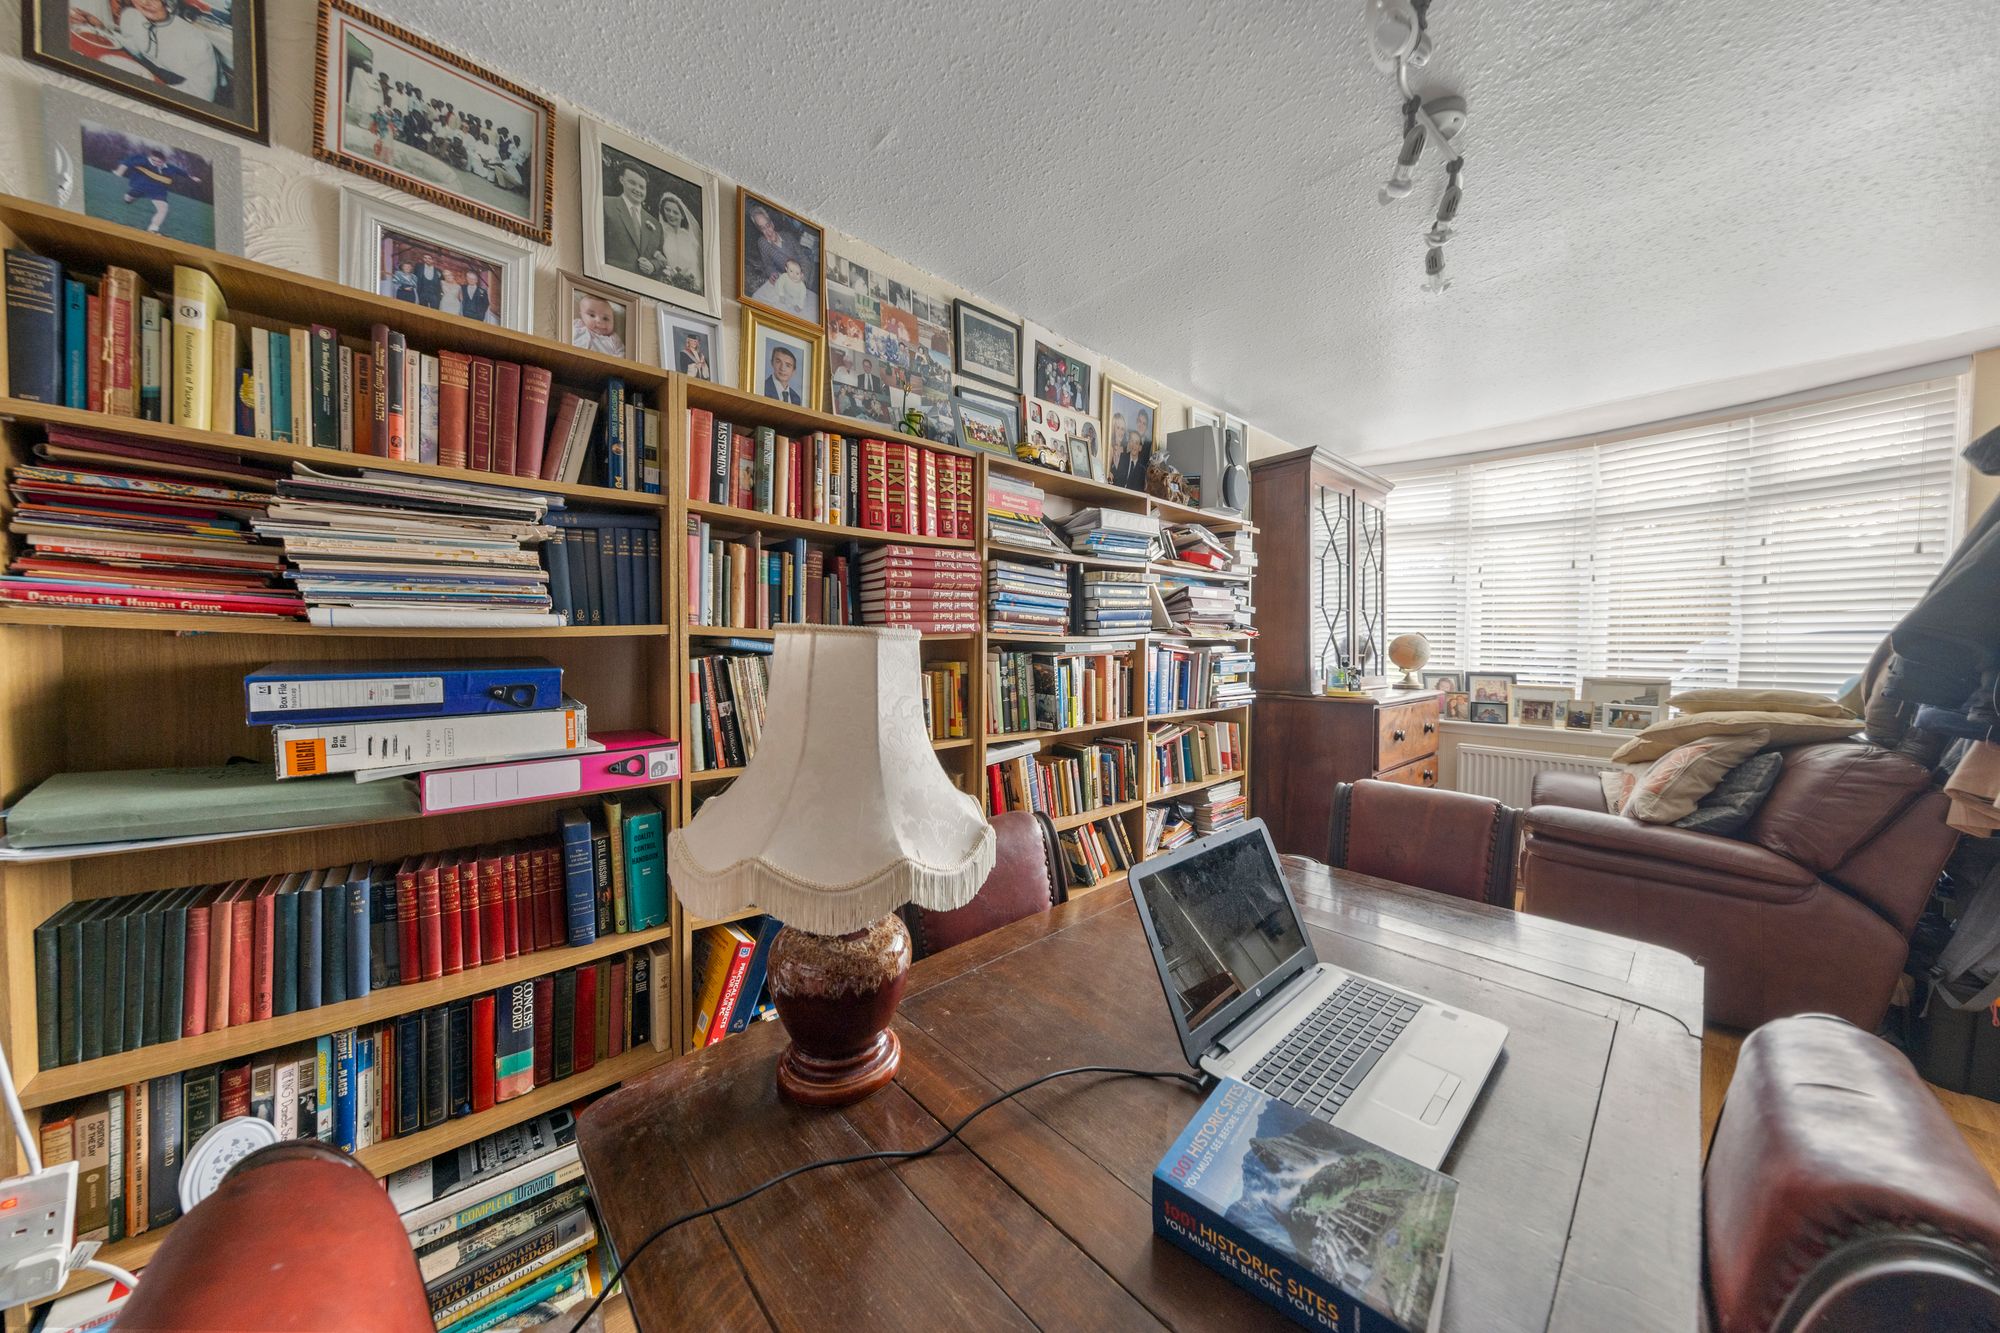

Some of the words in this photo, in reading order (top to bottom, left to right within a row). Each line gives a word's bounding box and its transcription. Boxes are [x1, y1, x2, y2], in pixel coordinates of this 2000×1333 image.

[183, 331, 195, 374] Fundamentals
[374, 367, 385, 391] Family
[183, 385, 195, 418] Packaging
[375, 391, 385, 422] HEALTH
[716, 421, 728, 476] MASTERMIND
[850, 456, 858, 493] CHAMPIONS
[867, 454, 885, 484] FIX
[887, 458, 905, 487] FIX
[908, 462, 918, 492] FIX
[926, 464, 936, 493] FIX
[938, 468, 955, 496] FIX
[956, 470, 972, 498] FIX
[867, 486, 885, 504] IT
[887, 490, 905, 506] IT
[927, 494, 937, 512] IT
[939, 497, 955, 513] IT
[957, 499, 972, 514] IT
[895, 514, 901, 523] 2
[945, 520, 951, 529] 5
[961, 522, 968, 530] 6
[63, 545, 105, 557] Practical
[105, 549, 124, 558] First
[124, 551, 141, 559] Aid
[941, 551, 955, 559] Paint
[961, 552, 976, 560] Draw
[941, 561, 955, 569] Paint
[941, 572, 956, 580] Paint
[27, 591, 94, 606] Drawing
[97, 594, 121, 605] the
[125, 596, 176, 609] Human
[180, 599, 222, 613] Figure
[940, 602, 953, 610] Paint
[941, 623, 954, 632] Paint
[961, 623, 975, 632] Draw
[279, 683, 288, 694] File
[279, 694, 288, 709] Box
[331, 736, 339, 749] Box
[339, 735, 348, 748] File
[296, 740, 315, 772] HILLGATE
[633, 831, 655, 843] QUALITY
[633, 842, 657, 853] CONTROL
[597, 839, 606, 859] STILL
[631, 852, 659, 865] HANDBOOK
[598, 858, 608, 887] MISSING
[728, 975, 736, 989] FOR
[730, 962, 746, 997] PRACTICAL
[511, 985, 523, 1030] OXFORD
[523, 981, 534, 1027] CONCISE
[723, 989, 732, 1007] YOUR
[718, 1005, 726, 1016] PC
[720, 997, 734, 1029] PROJECTS
[337, 1033, 347, 1060] PEOPLE
[338, 1069, 348, 1098] PLACES
[87, 1123, 96, 1131] OF
[96, 1119, 105, 1149] POSITION
[1169, 1154, 1195, 1184] 1001
[1186, 1106, 1229, 1159] HISTORIC
[1220, 1084, 1246, 1110] SITES
[87, 1132, 96, 1145] THE
[1183, 1171, 1201, 1189] YOU
[1197, 1150, 1214, 1174] MUST
[1210, 1138, 1224, 1153] SEE
[1219, 1114, 1240, 1143] BEFORE
[1236, 1101, 1249, 1117] YOU
[1243, 1090, 1256, 1103] DIE
[88, 1145, 96, 1157] DAY
[461, 1193, 514, 1225] COMPLETE
[517, 1174, 554, 1201] Drawing
[545, 1192, 575, 1213] EARTH
[474, 1240, 541, 1280] DICTIONARY
[540, 1233, 553, 1245] OF
[474, 1241, 554, 1290] KNOWLEDGE
[1164, 1199, 1197, 1233] 1001
[1200, 1223, 1283, 1287] HISTORIC
[1287, 1278, 1340, 1321] SITES
[497, 1260, 545, 1287] GARDEN
[1163, 1215, 1186, 1236] YOU
[1188, 1231, 1217, 1256] MUST
[1219, 1251, 1239, 1270] SEE
[1240, 1264, 1284, 1298] BEFORE
[1286, 1292, 1315, 1317] YOU
[1317, 1312, 1339, 1333] DIE
